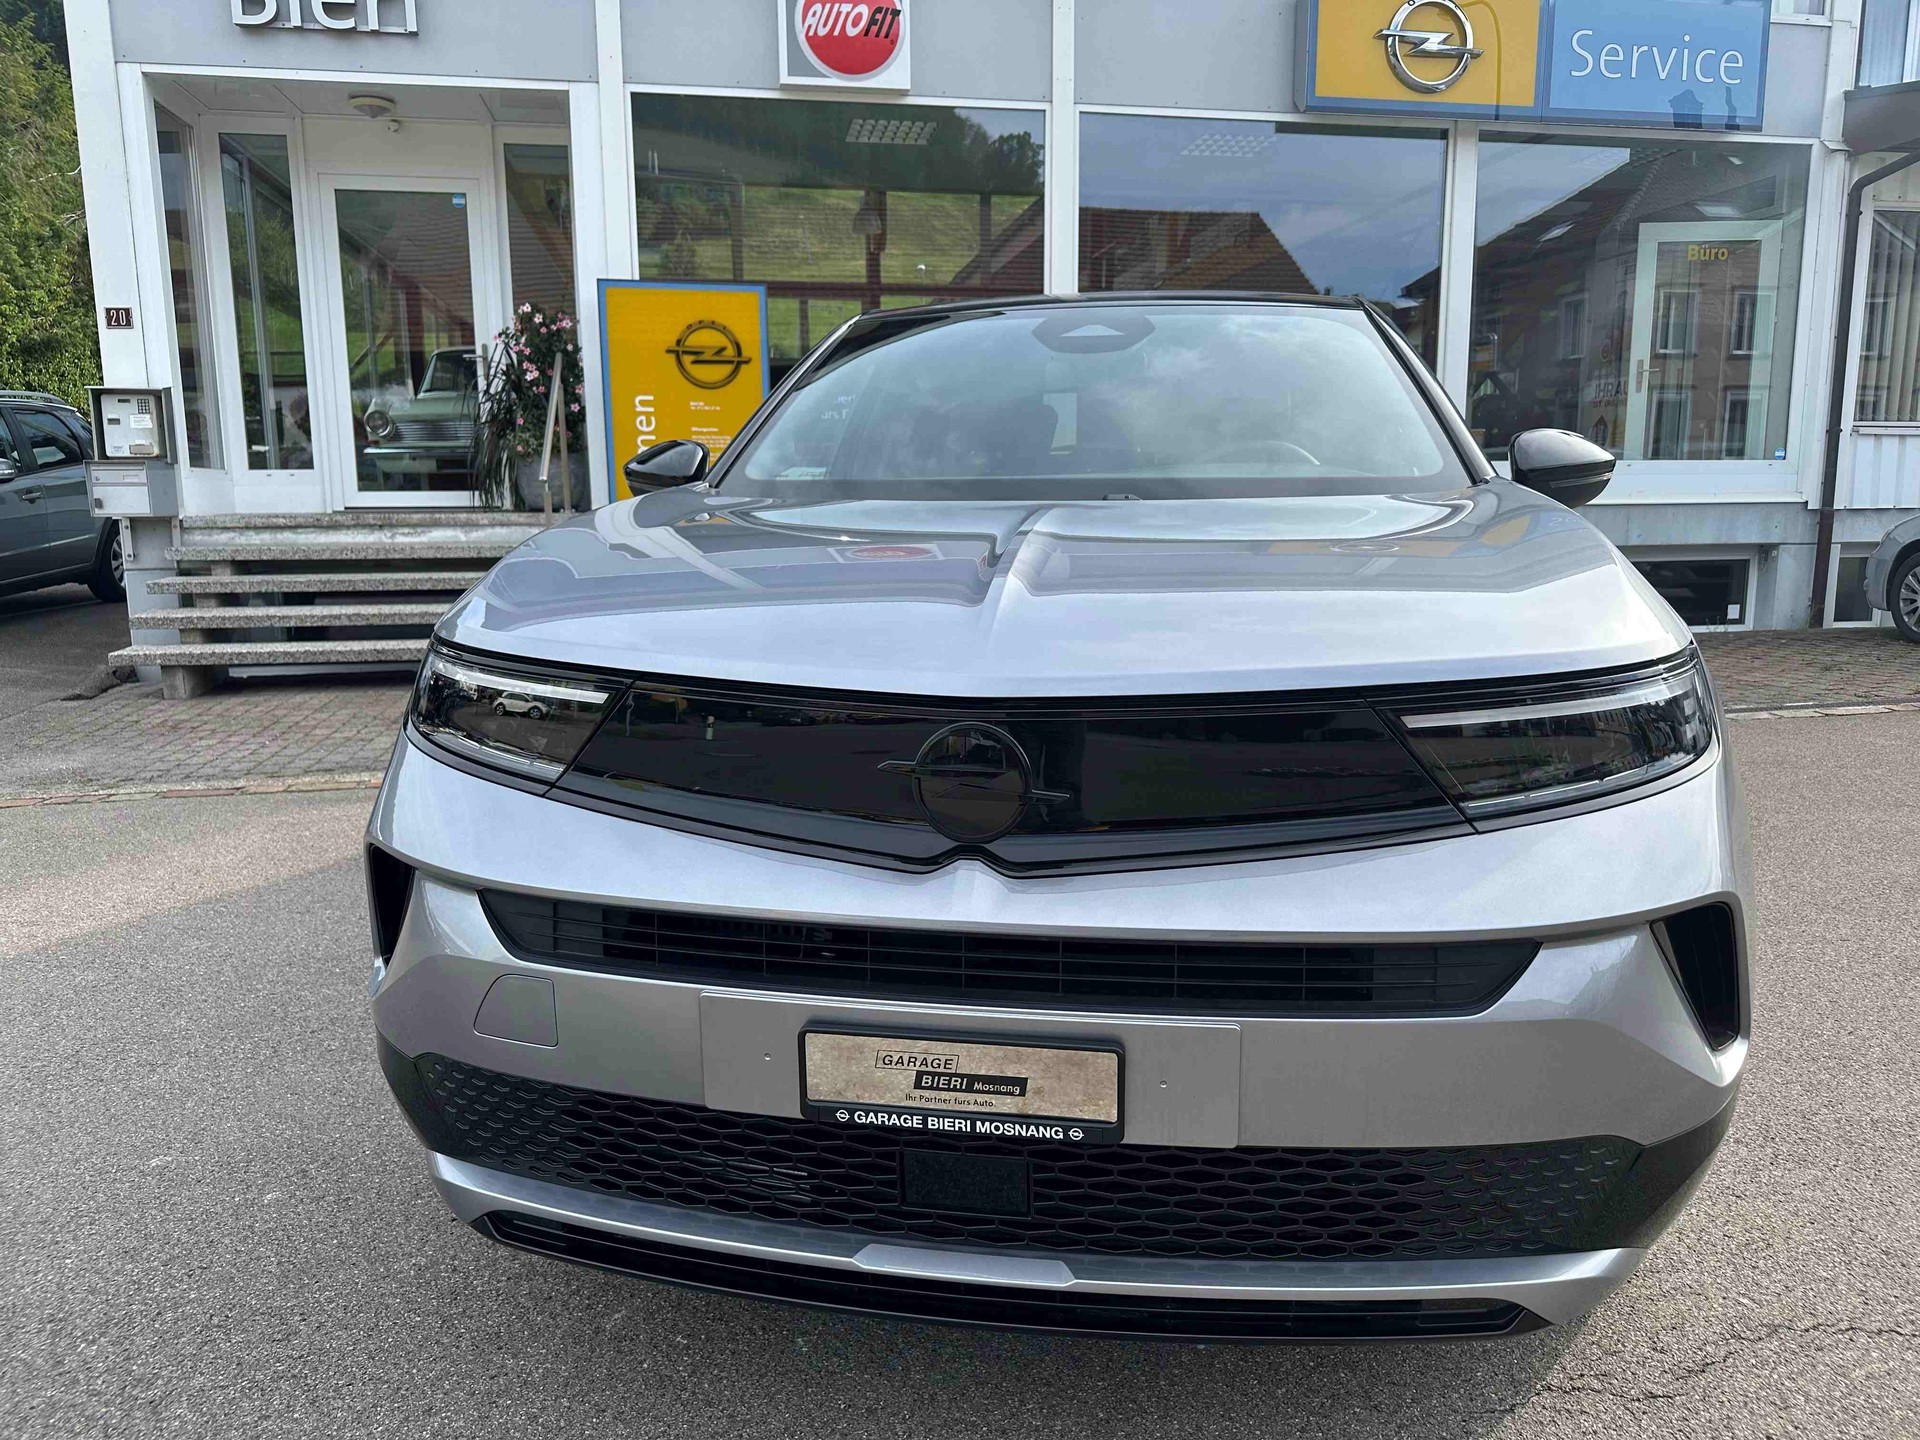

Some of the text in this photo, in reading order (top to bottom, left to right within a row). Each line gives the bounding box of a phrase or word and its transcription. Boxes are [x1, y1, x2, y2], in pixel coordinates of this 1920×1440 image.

[803, 3, 901, 39] AUTOFIT
[1570, 29, 1743, 84] Service
[1687, 243, 1728, 262] Büro
[110, 309, 126, 326] 20
[882, 1054, 954, 1070] GARAGE
[921, 1075, 1020, 1095] BIERI Mosnang
[905, 1093, 917, 1102] Ihr
[919, 1095, 951, 1105] Partner
[854, 1111, 1064, 1139] GARAGE BIERI MOSNANG
